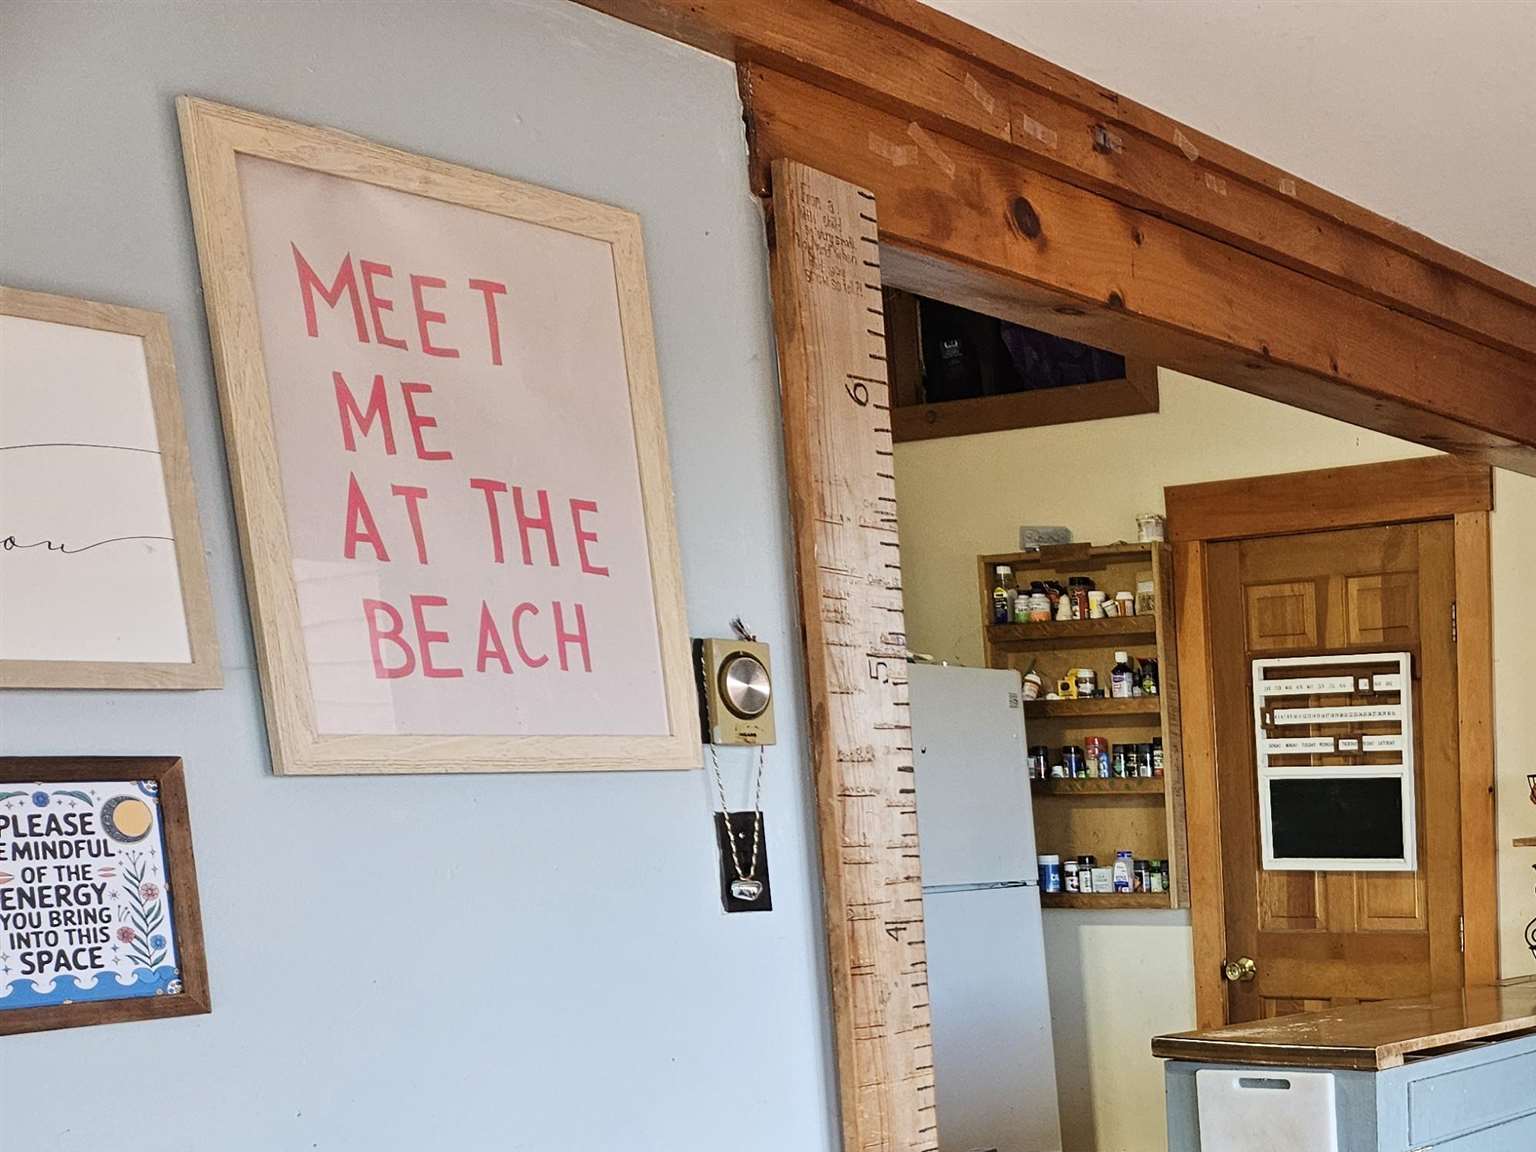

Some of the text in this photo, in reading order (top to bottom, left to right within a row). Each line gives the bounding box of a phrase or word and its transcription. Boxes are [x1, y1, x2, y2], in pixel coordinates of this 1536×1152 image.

[291, 241, 508, 367] MEET
[332, 371, 453, 462] ME
[343, 471, 610, 578] AT THE
[363, 594, 592, 680] BEACH
[0, 812, 96, 838] PLEASE
[11, 838, 116, 862] MINDFUL
[21, 864, 94, 884] OF THE
[0, 882, 107, 911] ENERGY
[0, 907, 112, 931] YOU BRING
[9, 926, 111, 951] INTO THIS
[20, 946, 105, 976] SPACE
